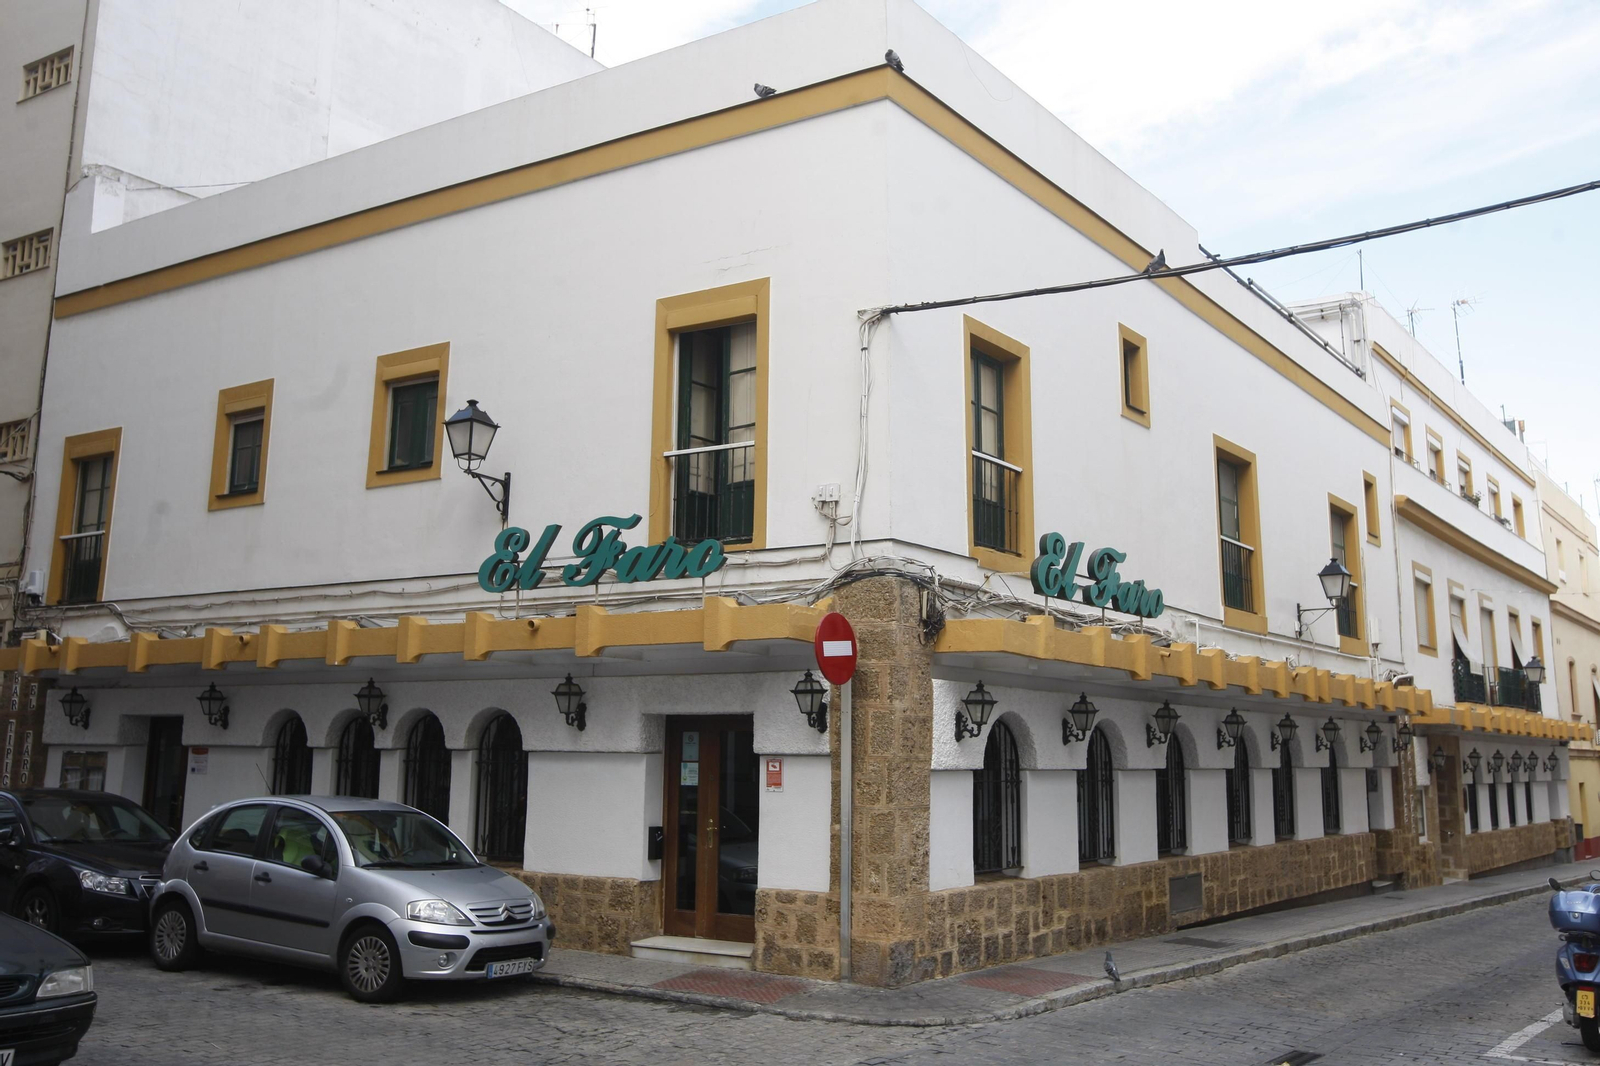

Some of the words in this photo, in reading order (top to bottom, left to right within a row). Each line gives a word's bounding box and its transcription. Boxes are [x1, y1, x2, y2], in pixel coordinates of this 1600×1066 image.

[478, 524, 562, 592] El
[562, 513, 728, 587] Faro
[1030, 532, 1086, 601] El
[1082, 547, 1165, 618] Faro
[11, 672, 20, 711] BAR
[29, 684, 37, 709] EL
[21, 732, 31, 784] FARO
[494, 963, 516, 975] 4927
